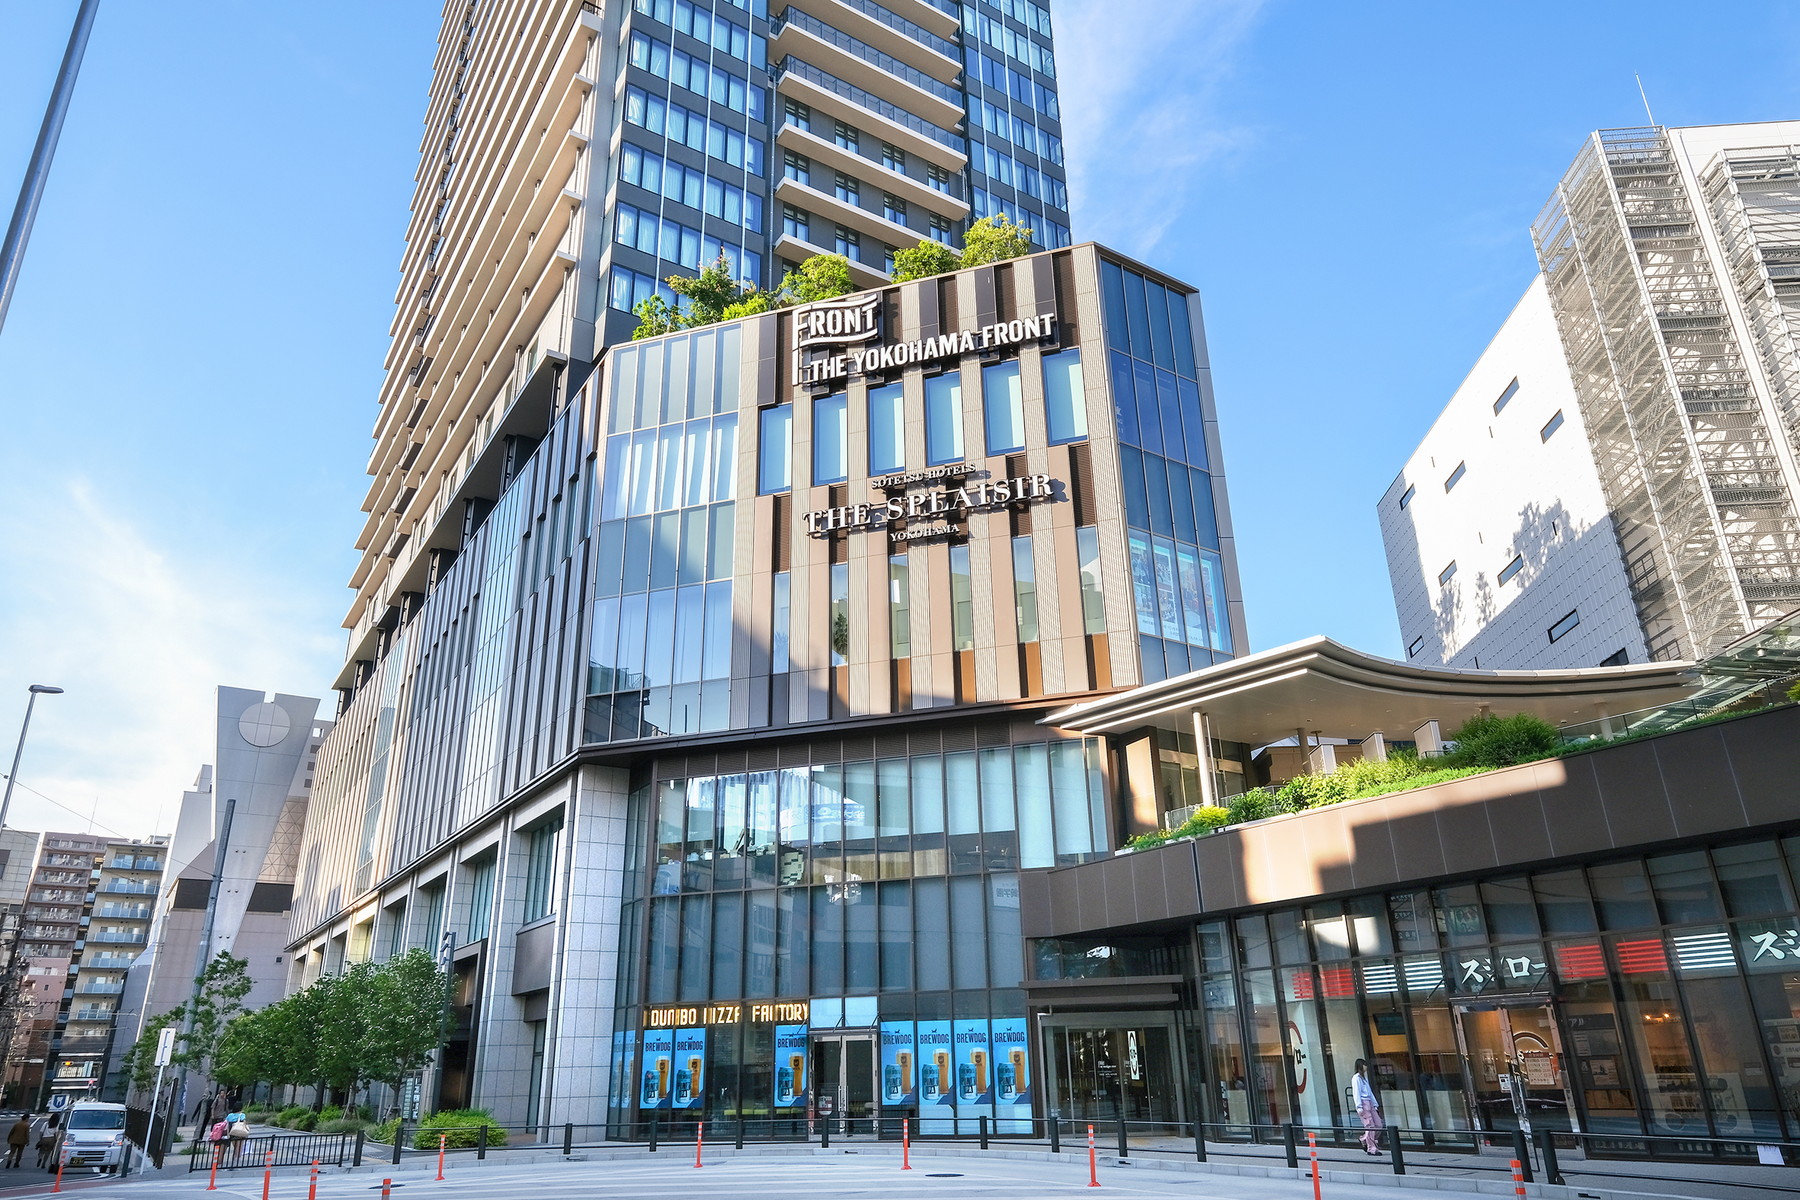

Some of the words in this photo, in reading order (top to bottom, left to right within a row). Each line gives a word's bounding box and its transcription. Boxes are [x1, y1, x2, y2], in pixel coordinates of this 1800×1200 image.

[792, 294, 877, 346] FRONT
[810, 354, 847, 381] THE
[853, 330, 974, 373] YOKOHAMA
[983, 313, 1055, 347] FRONT
[871, 472, 924, 488] SOTETSU
[928, 463, 976, 479] HOTELS
[802, 502, 872, 534] THE
[886, 473, 1054, 520] SPLAISIR
[890, 524, 960, 541] YOKOHAMA
[752, 1003, 808, 1022] FATORY
[778, 1037, 805, 1048] BREWDOG
[883, 1033, 912, 1045] BREWDOG
[920, 1033, 949, 1044] BREWDOG
[956, 1032, 987, 1044] BREWDOG
[994, 1031, 1025, 1043] BREWDOG
[645, 1041, 671, 1052] BREWDOG
[677, 1040, 704, 1051] BREWDOG
